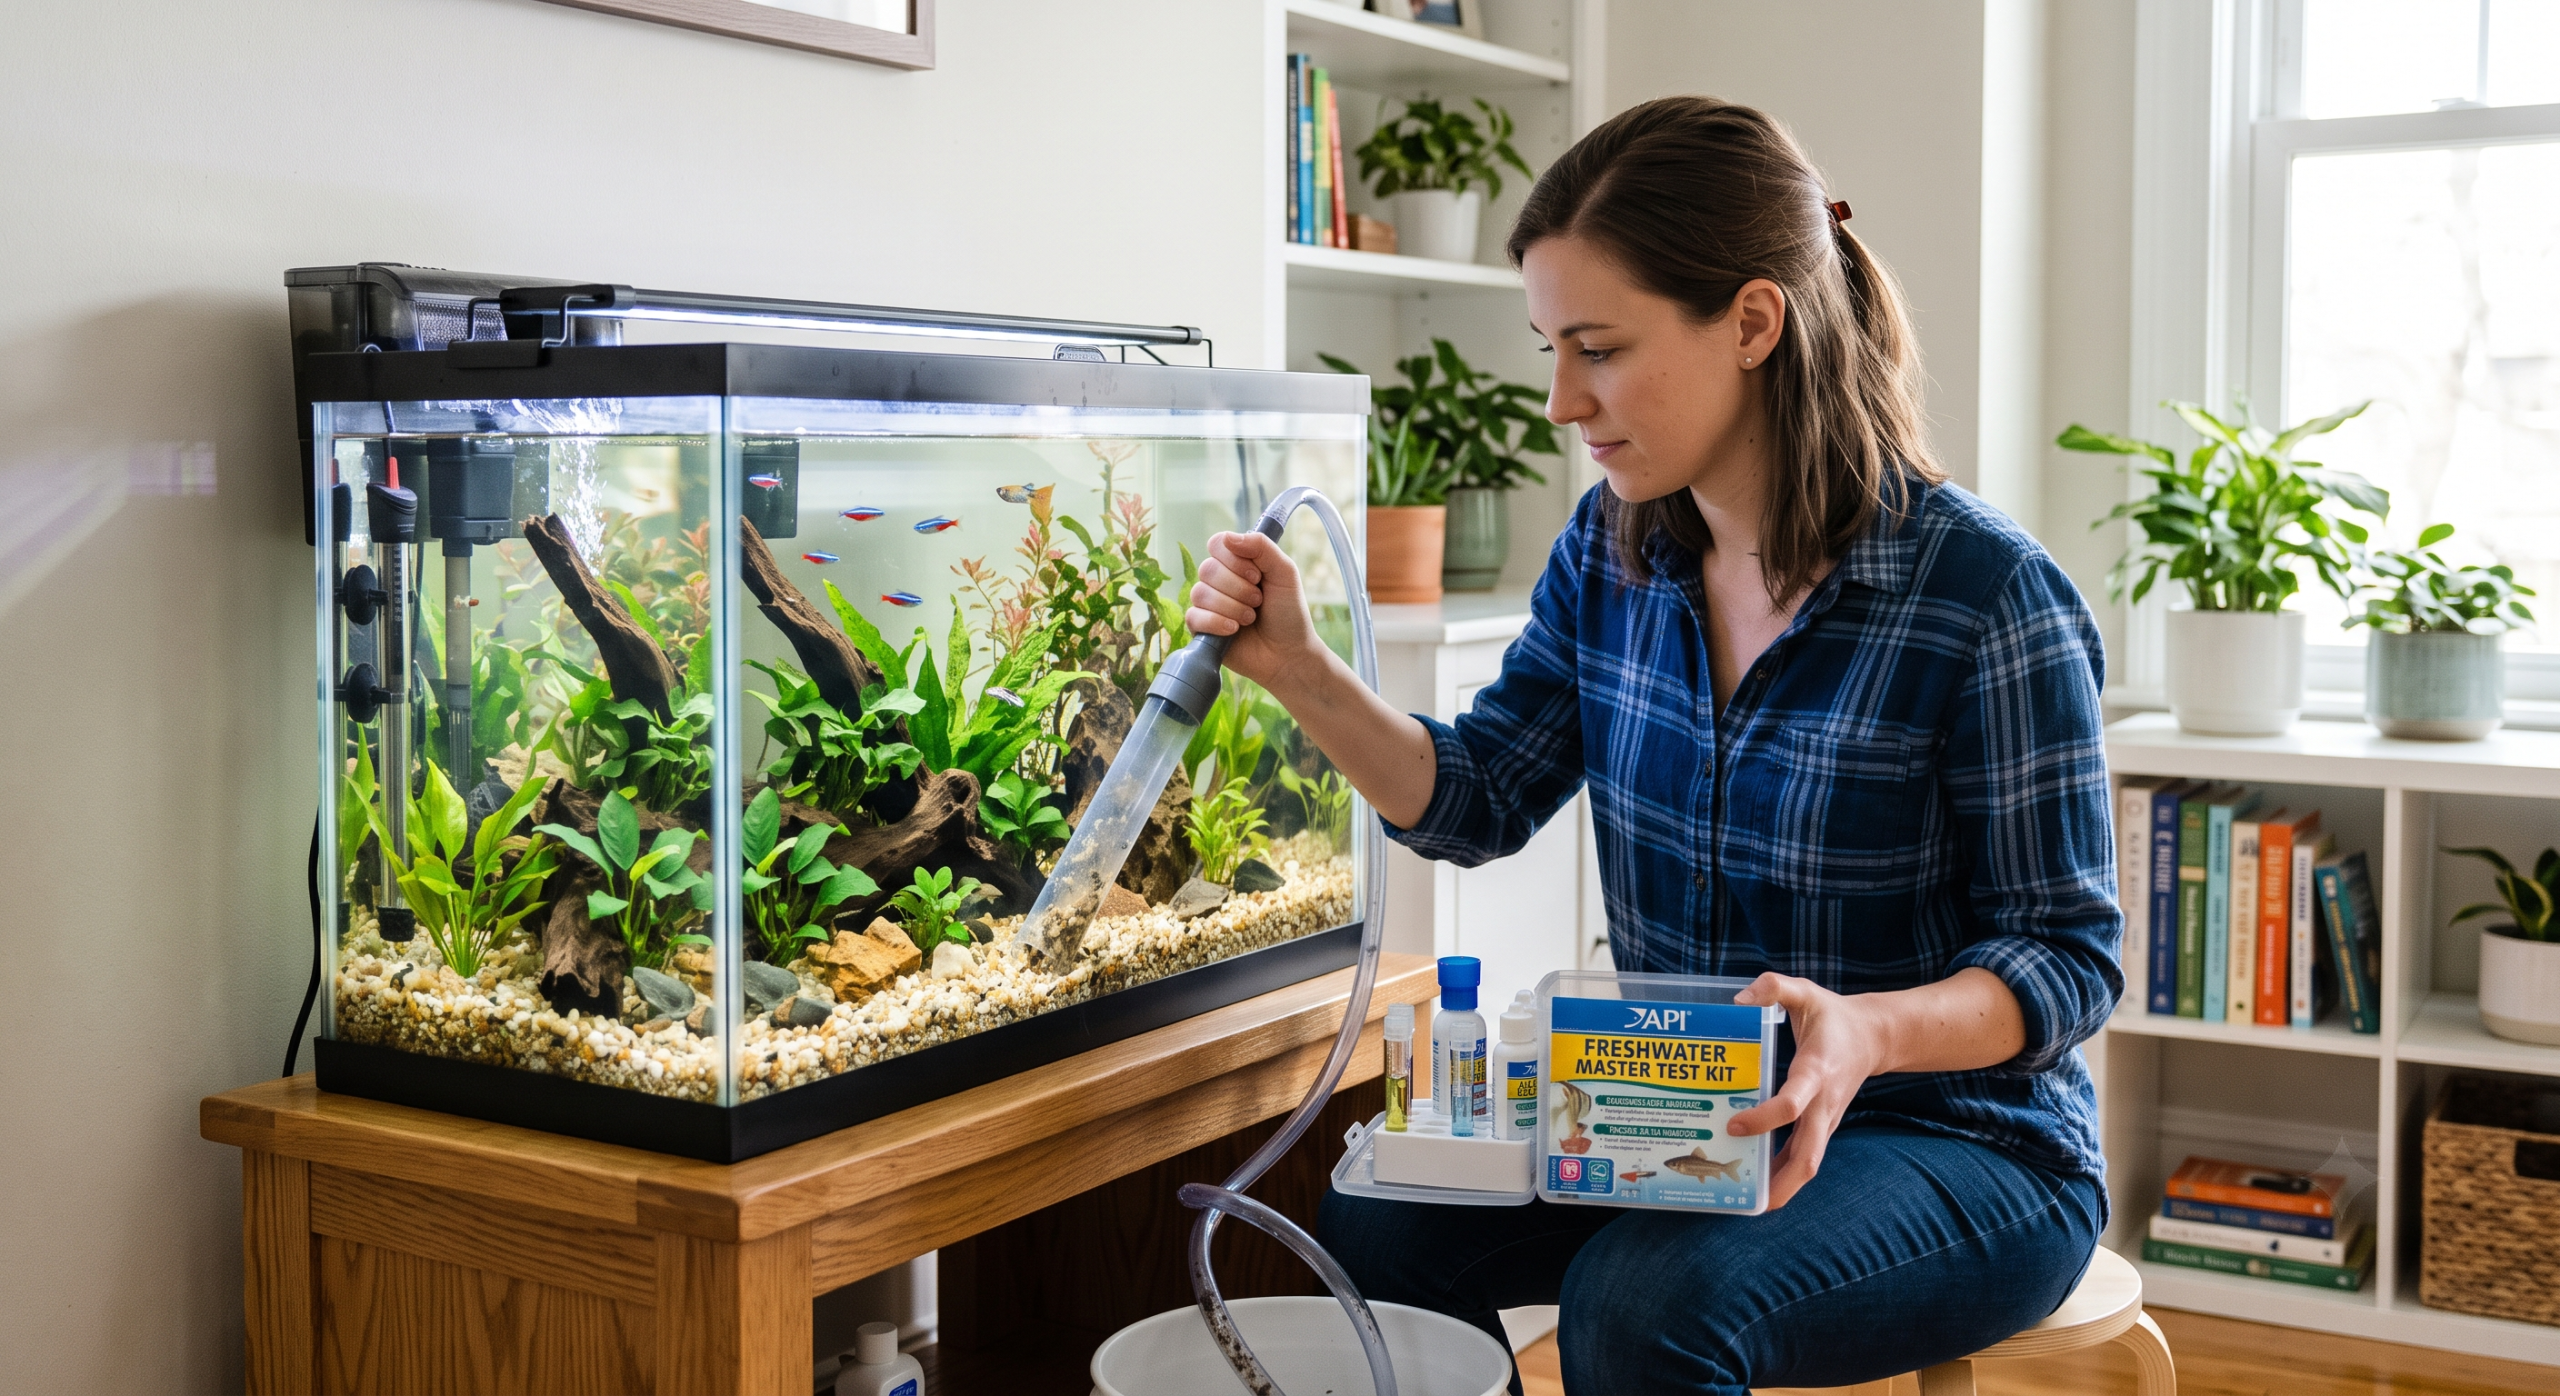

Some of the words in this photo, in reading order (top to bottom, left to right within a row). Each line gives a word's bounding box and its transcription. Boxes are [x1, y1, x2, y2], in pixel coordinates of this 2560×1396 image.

[1641, 1008, 1686, 1031] API
[1584, 1038, 1727, 1063] FRESHWATER
[1575, 1059, 1651, 1078] MASTER
[1656, 1063, 1700, 1080] TEST
[1706, 1065, 1736, 1082] KIT
